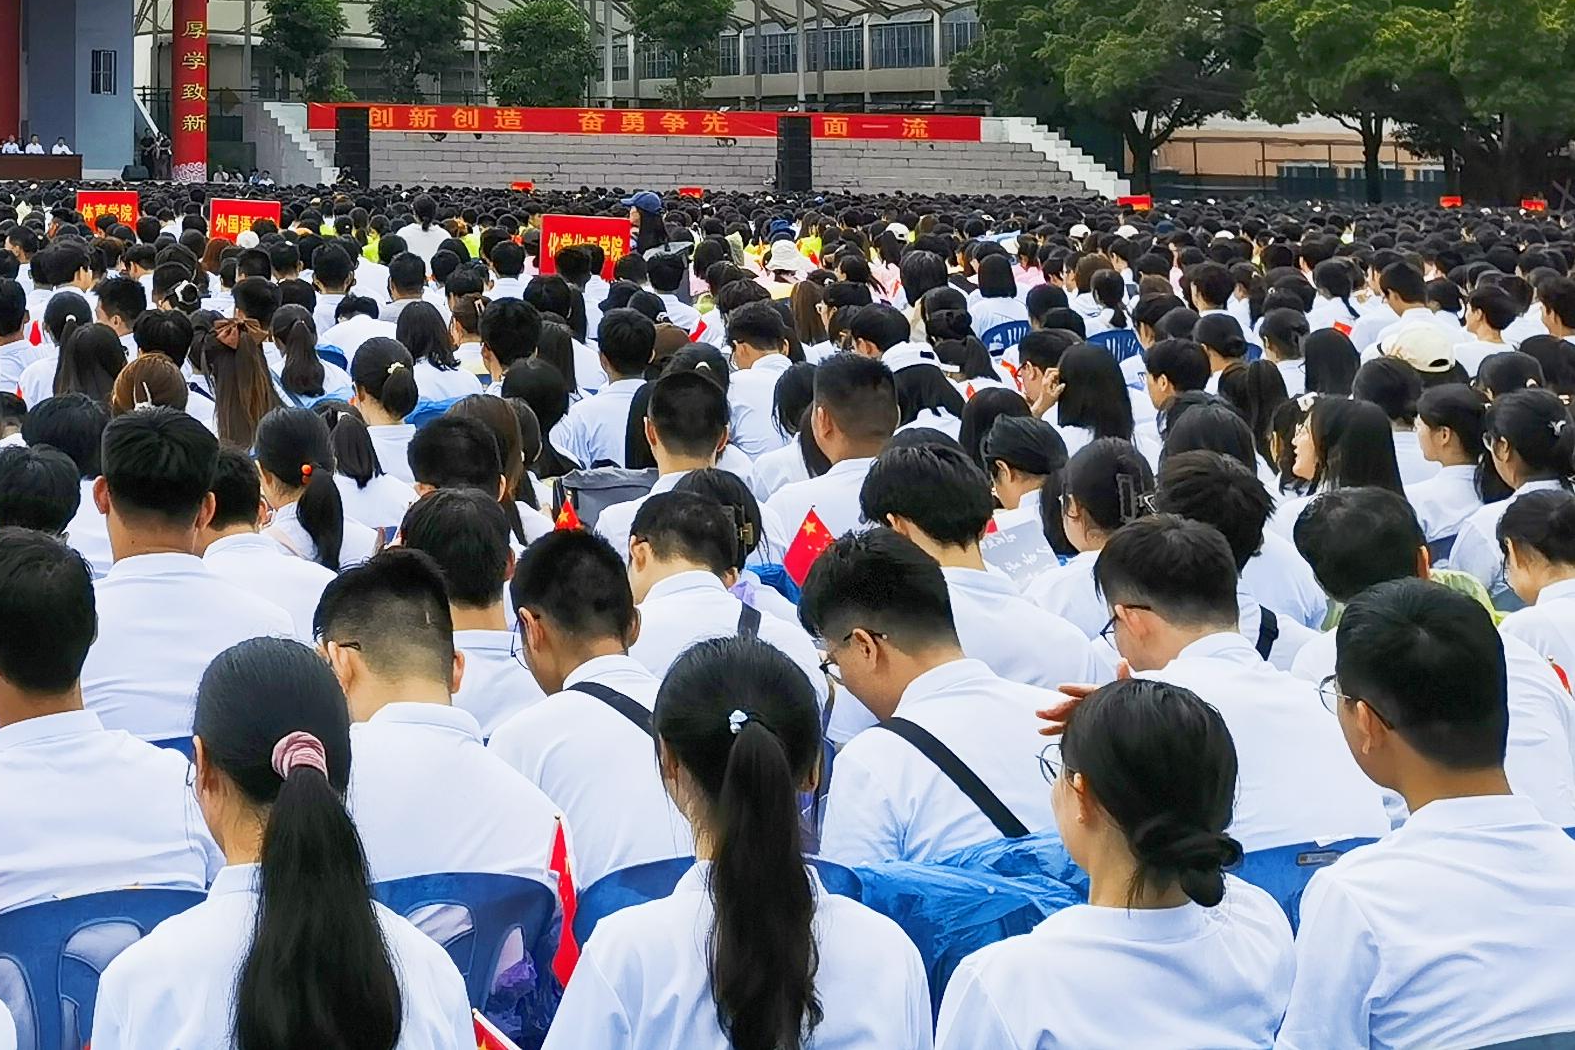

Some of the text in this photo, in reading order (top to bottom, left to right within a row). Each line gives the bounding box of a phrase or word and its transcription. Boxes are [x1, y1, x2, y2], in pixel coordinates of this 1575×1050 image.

[181, 20, 207, 132] 厚学致新
[369, 106, 929, 139] 创新创造 奋勇争先 面一流
[215, 213, 276, 234] 外国语
